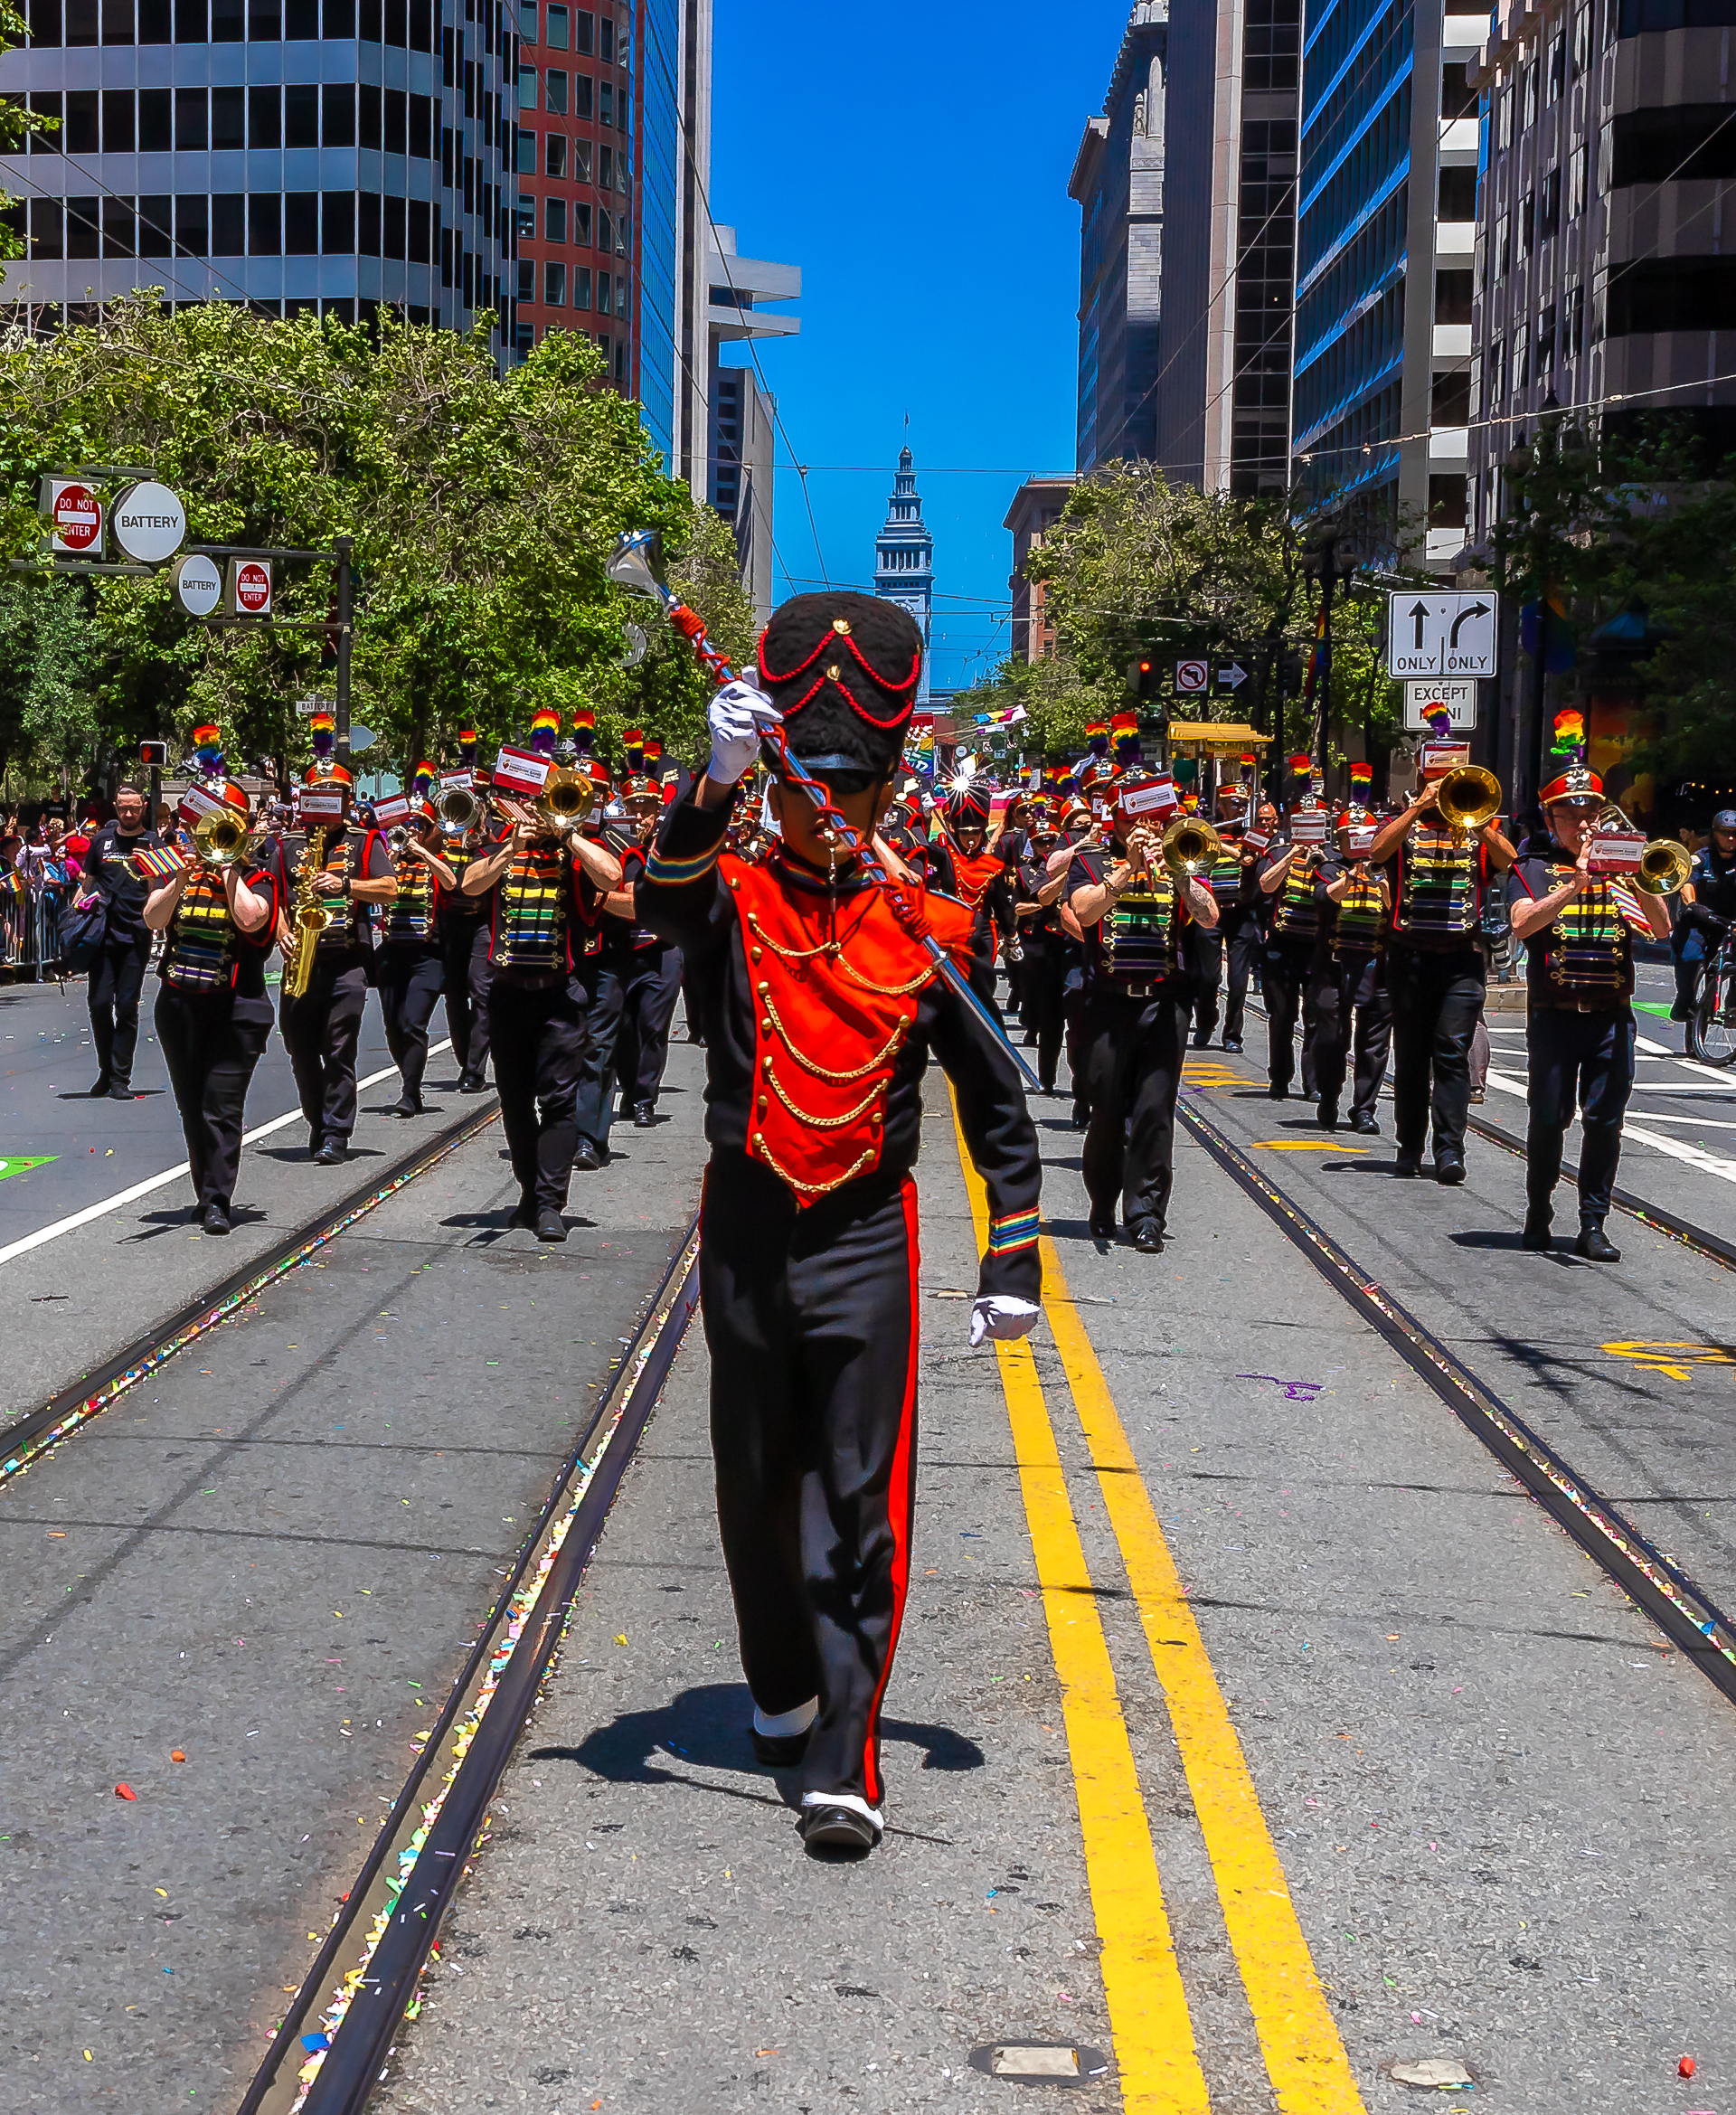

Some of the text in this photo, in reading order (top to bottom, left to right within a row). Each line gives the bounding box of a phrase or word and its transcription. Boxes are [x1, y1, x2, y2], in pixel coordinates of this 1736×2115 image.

[60, 497, 94, 511] DO NOT
[121, 515, 179, 528] BATTERY
[182, 579, 217, 590] BATTERY
[241, 573, 265, 583] DO NOT
[243, 593, 262, 602] ENTER
[1397, 656, 1488, 670] ONLY ONLY
[1414, 686, 1468, 701] EXCEPT
[1419, 707, 1461, 721] NI
